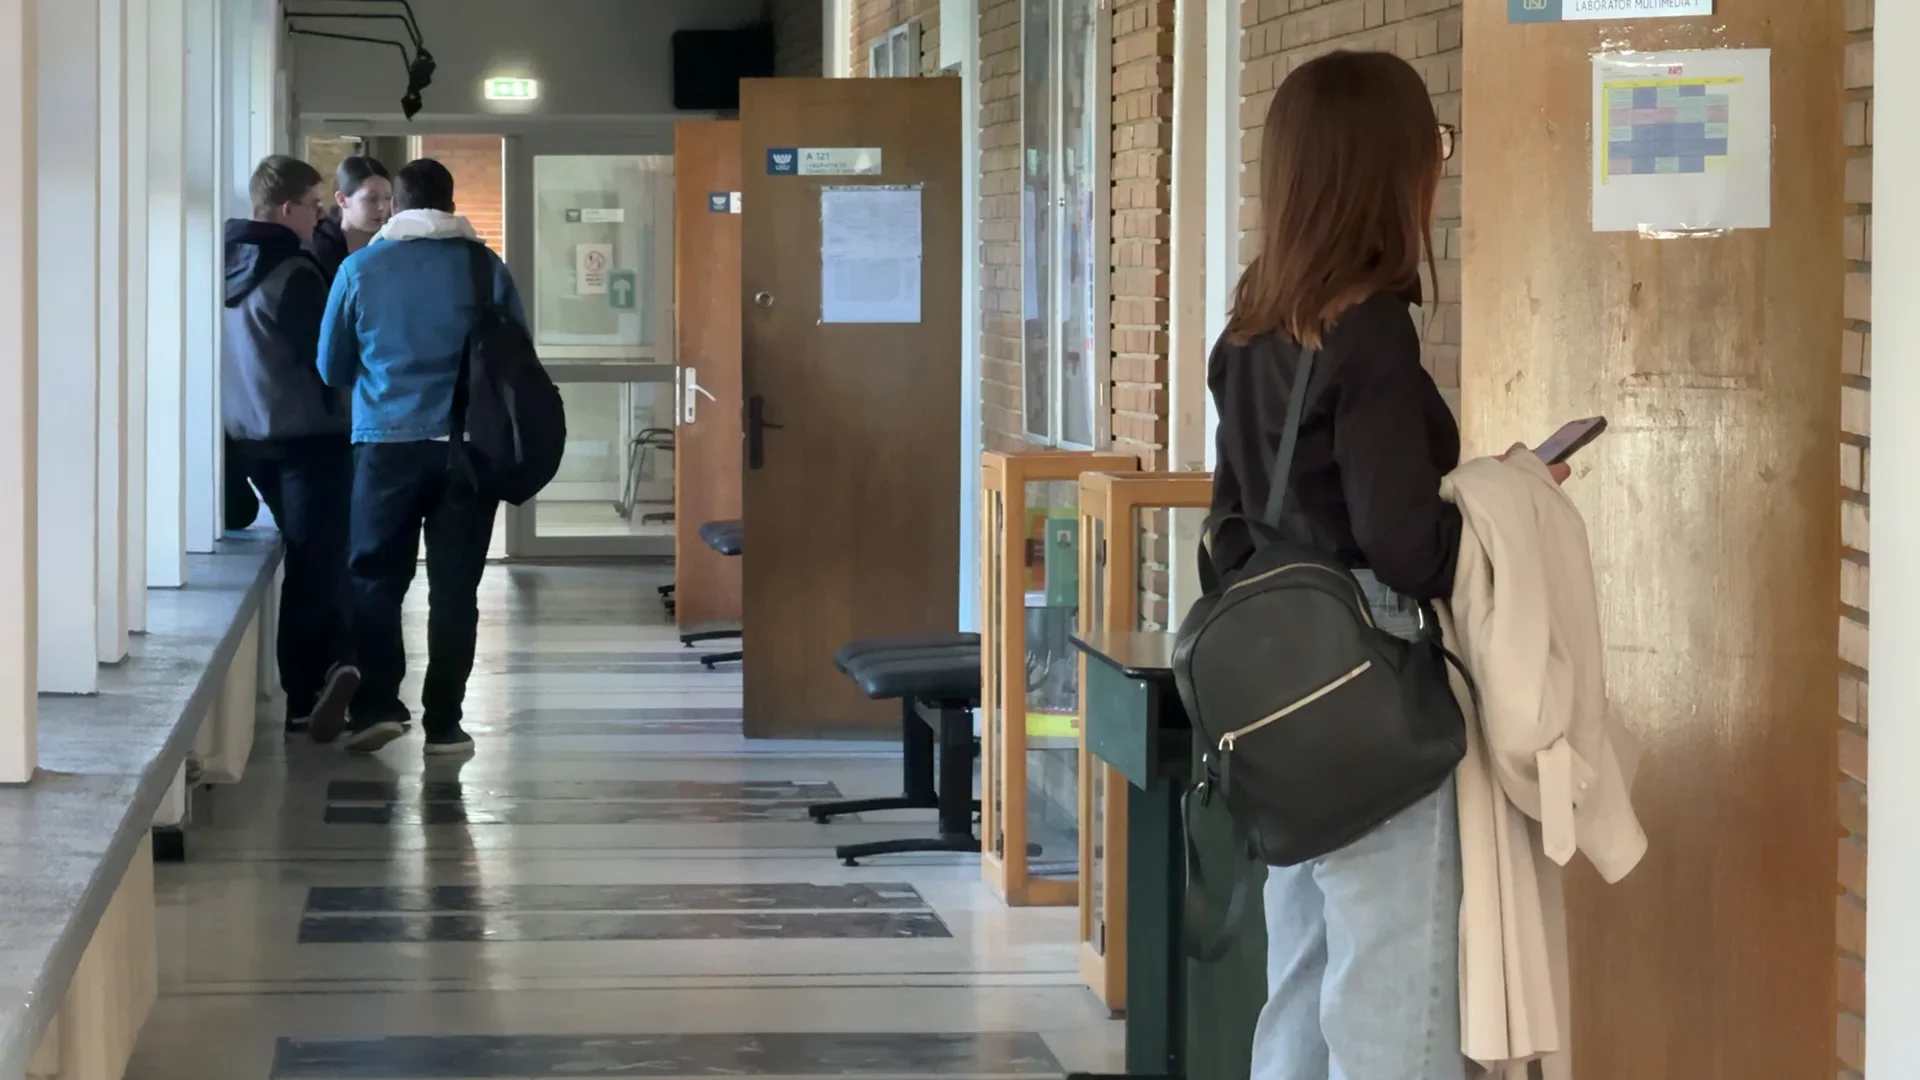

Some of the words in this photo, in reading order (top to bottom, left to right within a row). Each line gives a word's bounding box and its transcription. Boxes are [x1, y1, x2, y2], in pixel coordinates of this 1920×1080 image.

[1575, 0, 1632, 12] LABORATOR
[1634, 0, 1691, 9] MULTIMEDIA
[806, 152, 813, 160] A
[816, 152, 830, 160] 121
